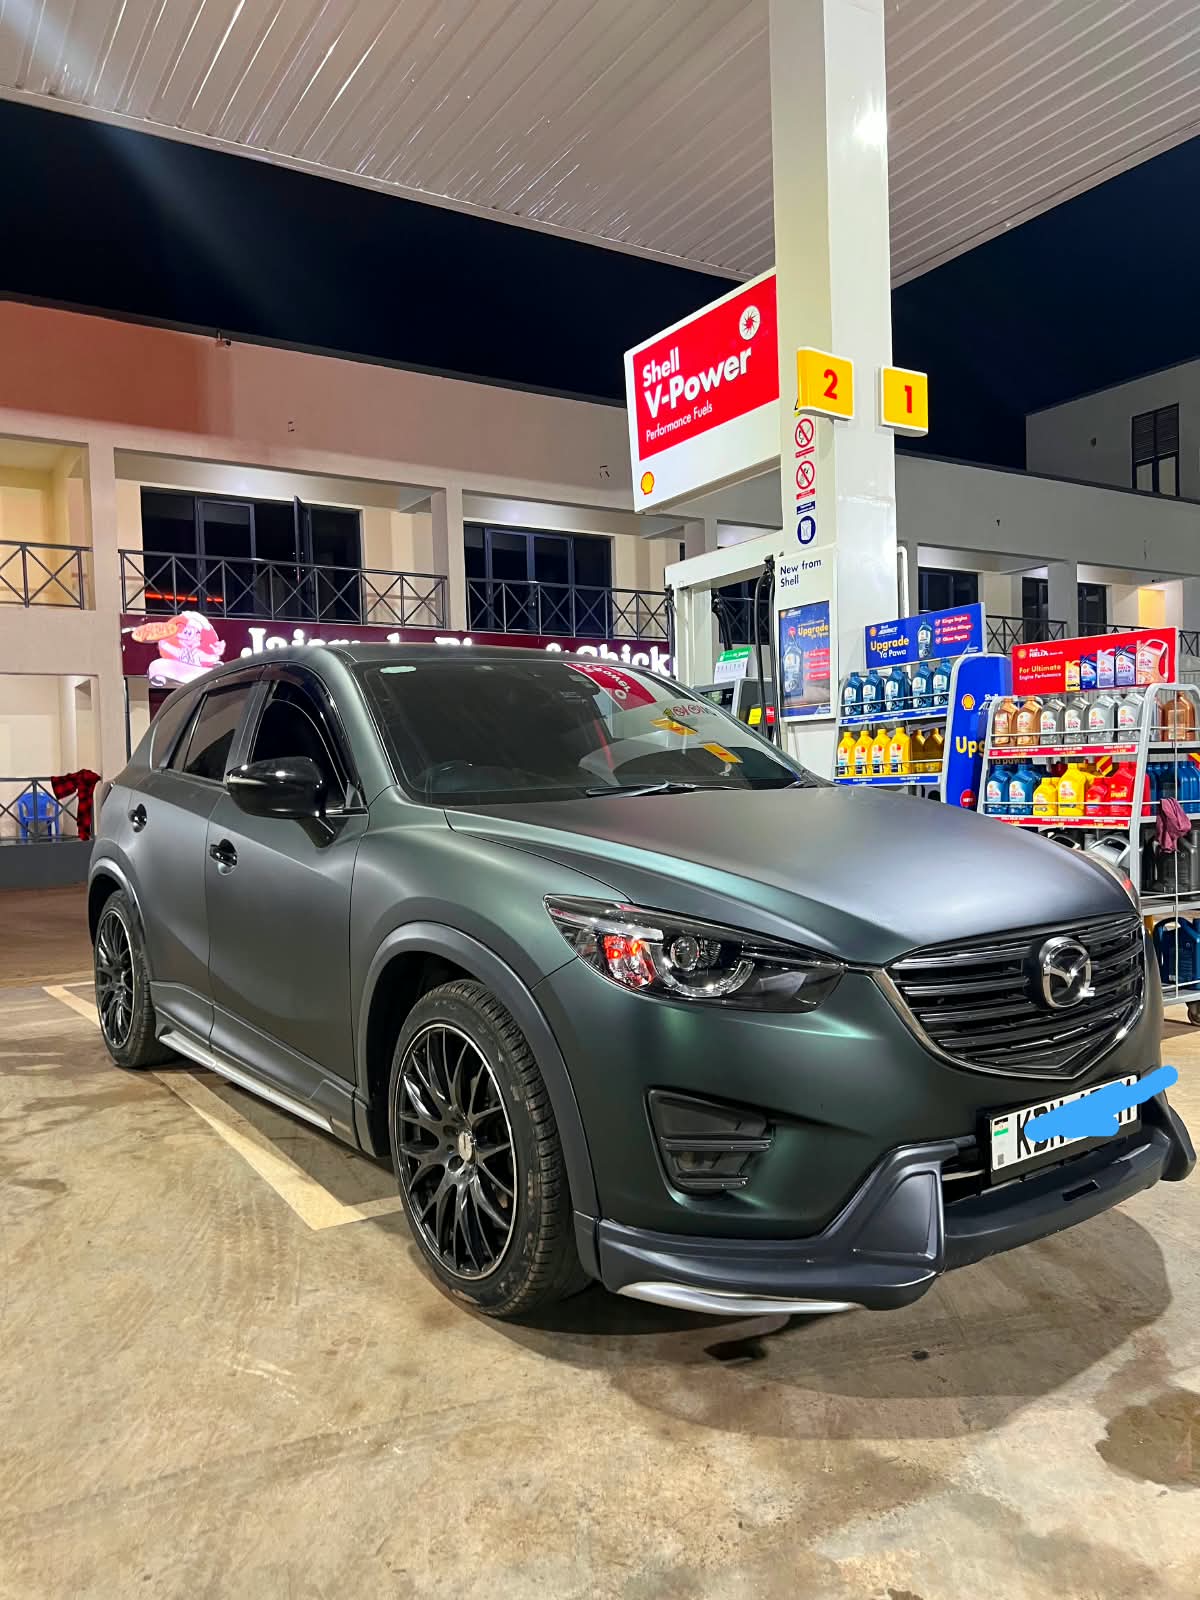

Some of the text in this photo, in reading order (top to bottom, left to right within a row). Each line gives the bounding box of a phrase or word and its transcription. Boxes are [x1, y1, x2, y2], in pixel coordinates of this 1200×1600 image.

[643, 346, 680, 388] Shell
[644, 347, 752, 418] V-Power
[823, 369, 838, 400] 2
[904, 385, 912, 413] 1
[646, 400, 713, 442] Performance Fuels
[780, 559, 821, 575] New from
[780, 574, 799, 588] Shell
[870, 635, 909, 653] Upgrade
[888, 649, 907, 658] Pawa
[1031, 665, 1062, 673] Ultimate
